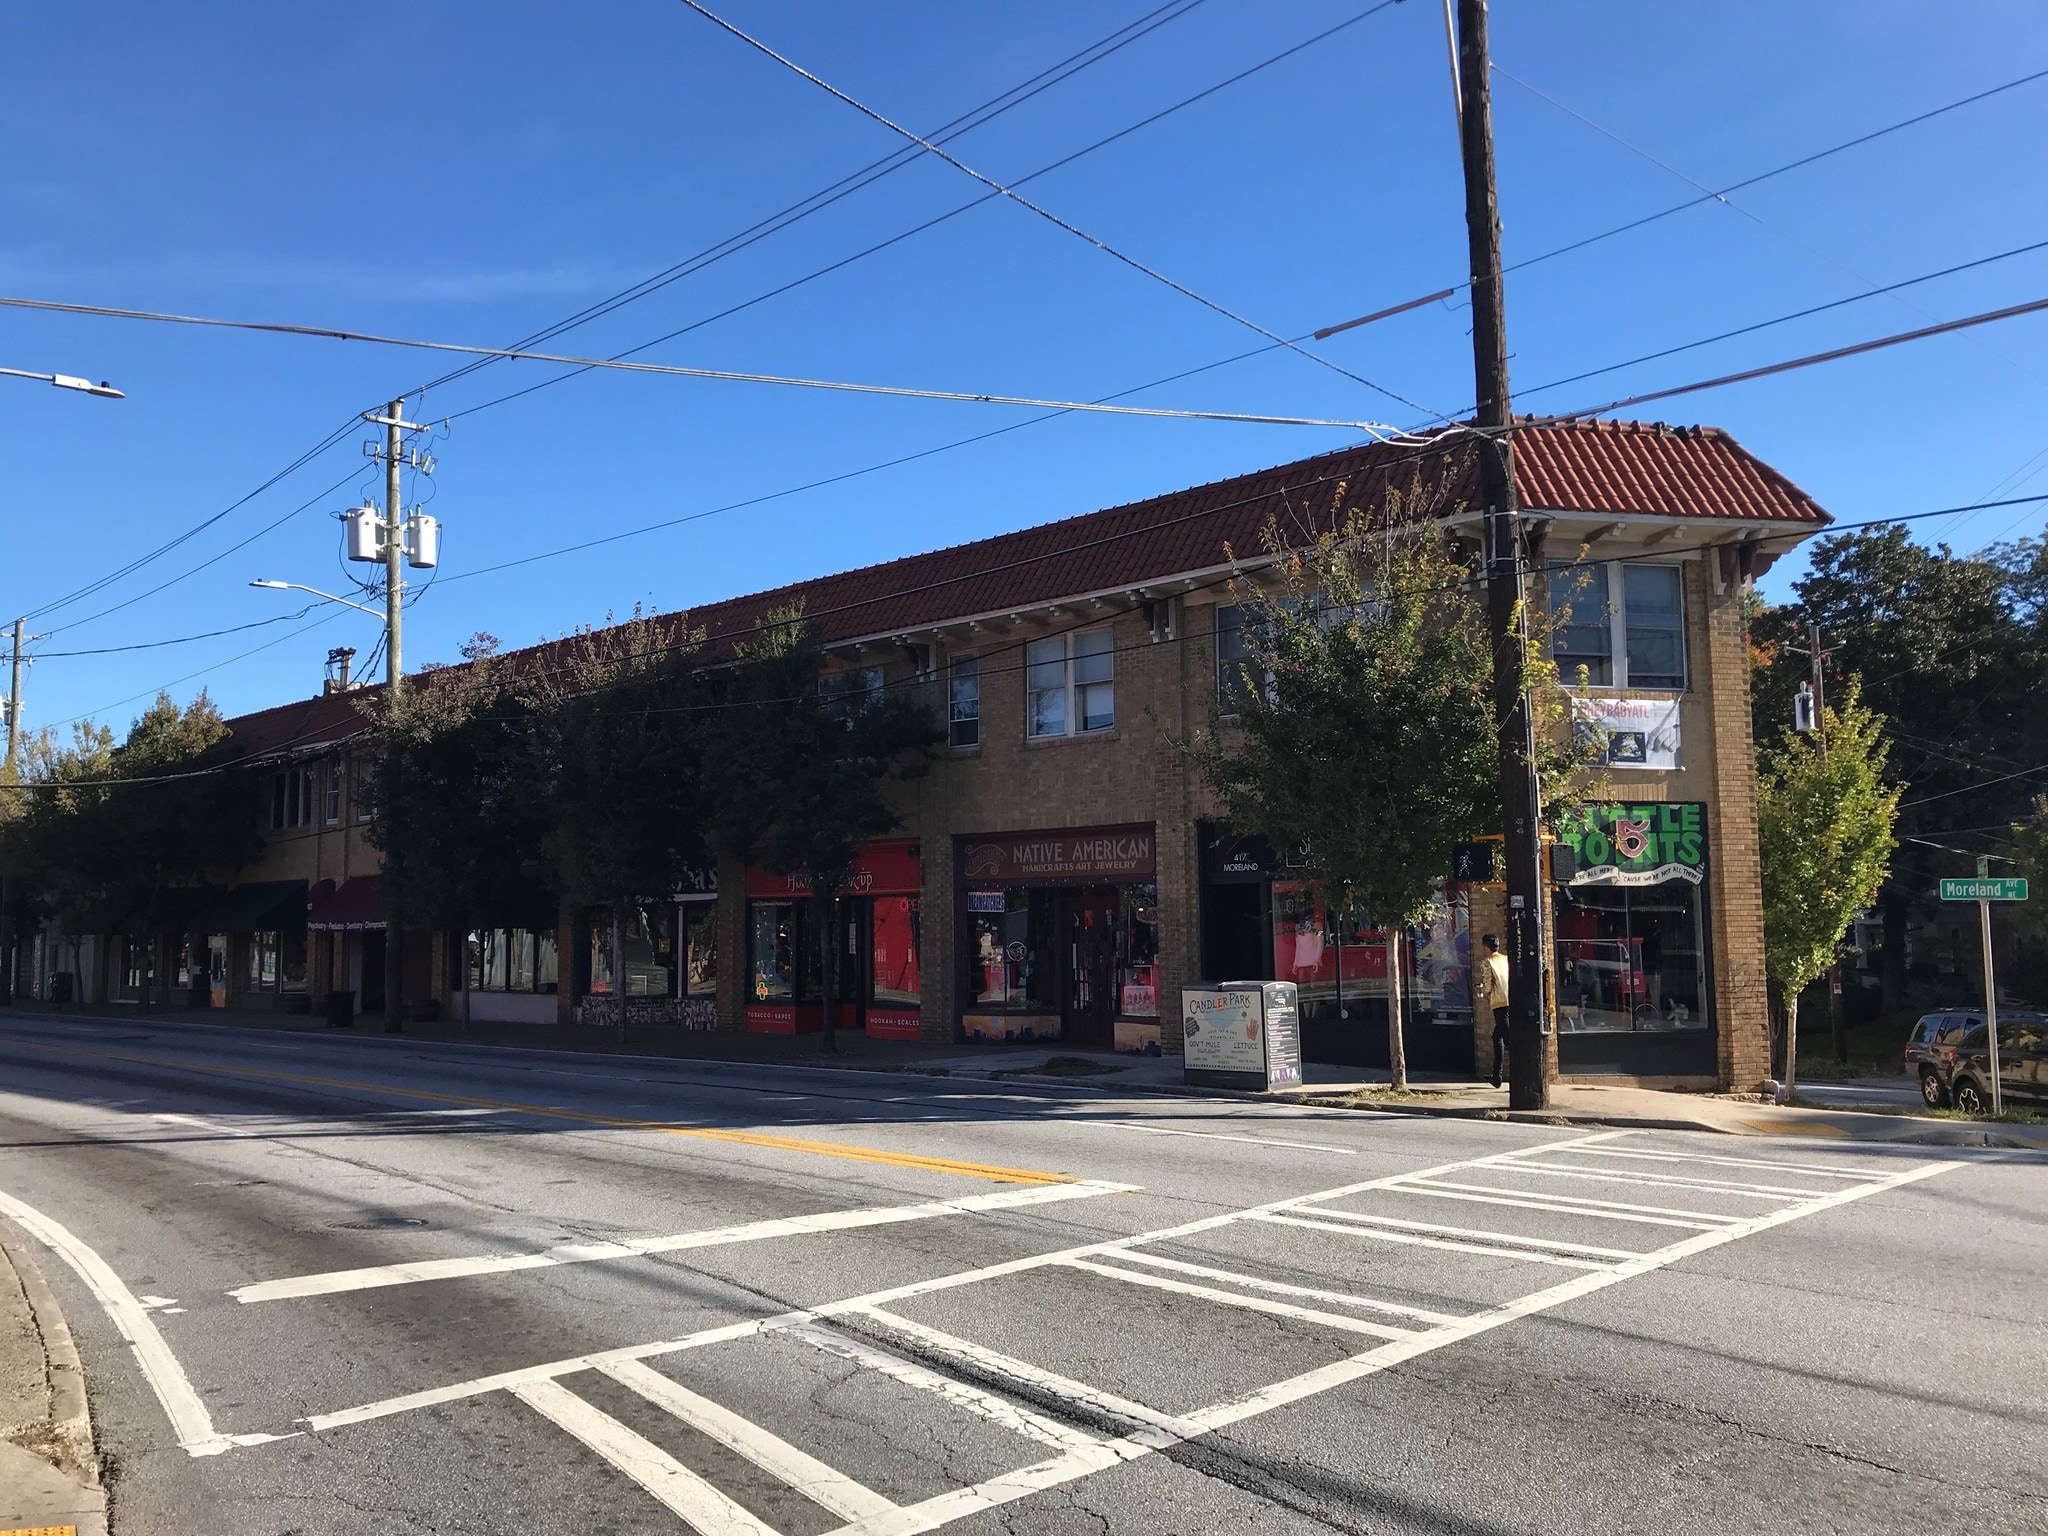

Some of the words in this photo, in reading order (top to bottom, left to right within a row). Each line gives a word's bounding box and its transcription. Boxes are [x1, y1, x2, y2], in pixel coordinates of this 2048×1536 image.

[1562, 804, 1701, 832] ITTLE
[1616, 820, 1651, 858] 5
[1013, 842, 1063, 864] NATIVE
[1072, 838, 1149, 861] AMERICAN
[1023, 860, 1074, 873] HANDCRAFTS
[1075, 862, 1092, 871] ART
[1094, 859, 1137, 870] JEWELRY
[1223, 862, 1259, 872] MORELAND
[1946, 882, 2001, 896] Moreland
[2005, 880, 2018, 888] AVE
[1190, 998, 1228, 1014] CANDLER
[1229, 993, 1251, 1008] PARK
[897, 1018, 920, 1026] SCALES
